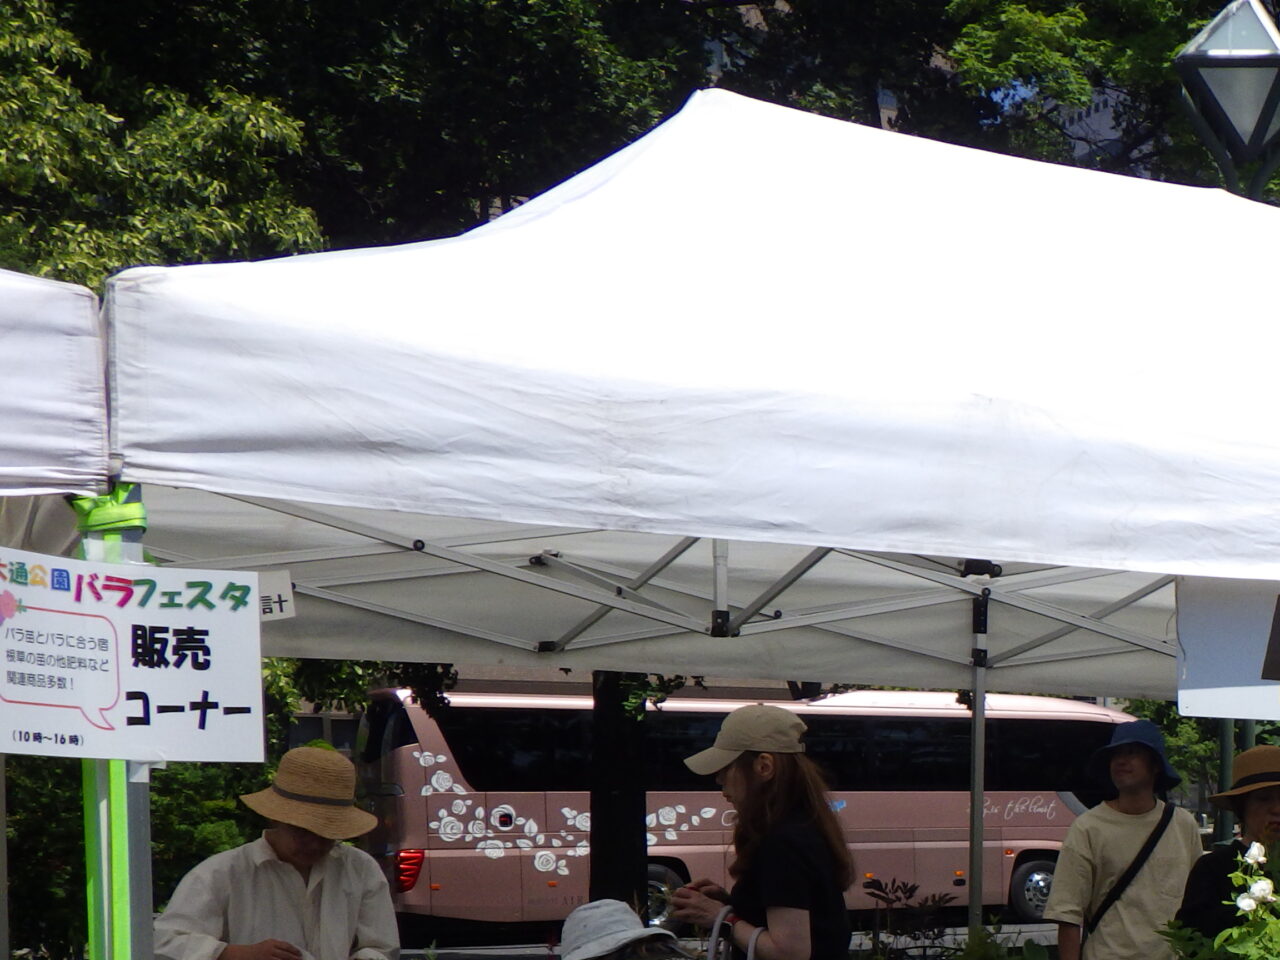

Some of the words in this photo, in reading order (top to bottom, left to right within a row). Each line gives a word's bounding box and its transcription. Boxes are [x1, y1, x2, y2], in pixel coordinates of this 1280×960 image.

[260, 594, 288, 615] 計
[131, 624, 211, 671] 販売
[125, 690, 251, 730] コーナー
